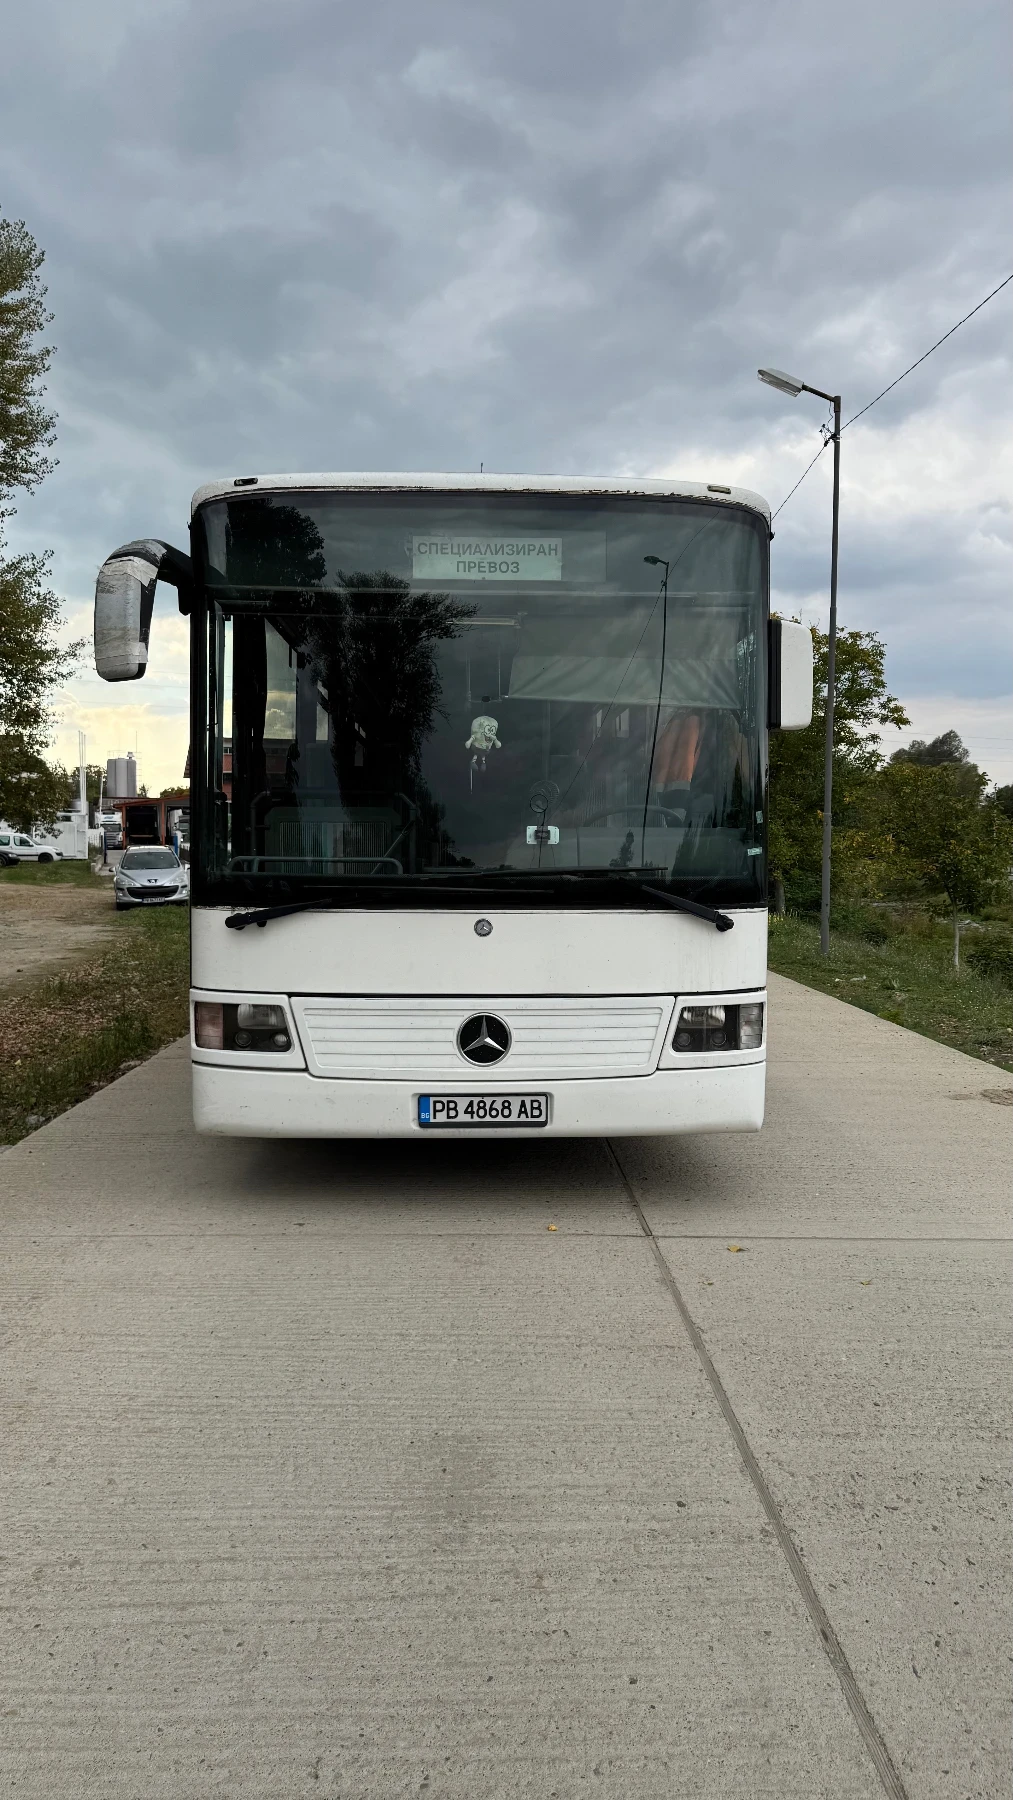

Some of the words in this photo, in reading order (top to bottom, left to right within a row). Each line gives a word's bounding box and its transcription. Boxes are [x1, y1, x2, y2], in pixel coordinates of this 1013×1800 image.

[417, 542, 558, 557] СПЕЦИАЛИЗИРАН
[456, 561, 520, 574] ПРЕВОЗ
[433, 1100, 459, 1119] PB
[463, 1100, 512, 1119] 4868
[517, 1099, 543, 1119] AB
